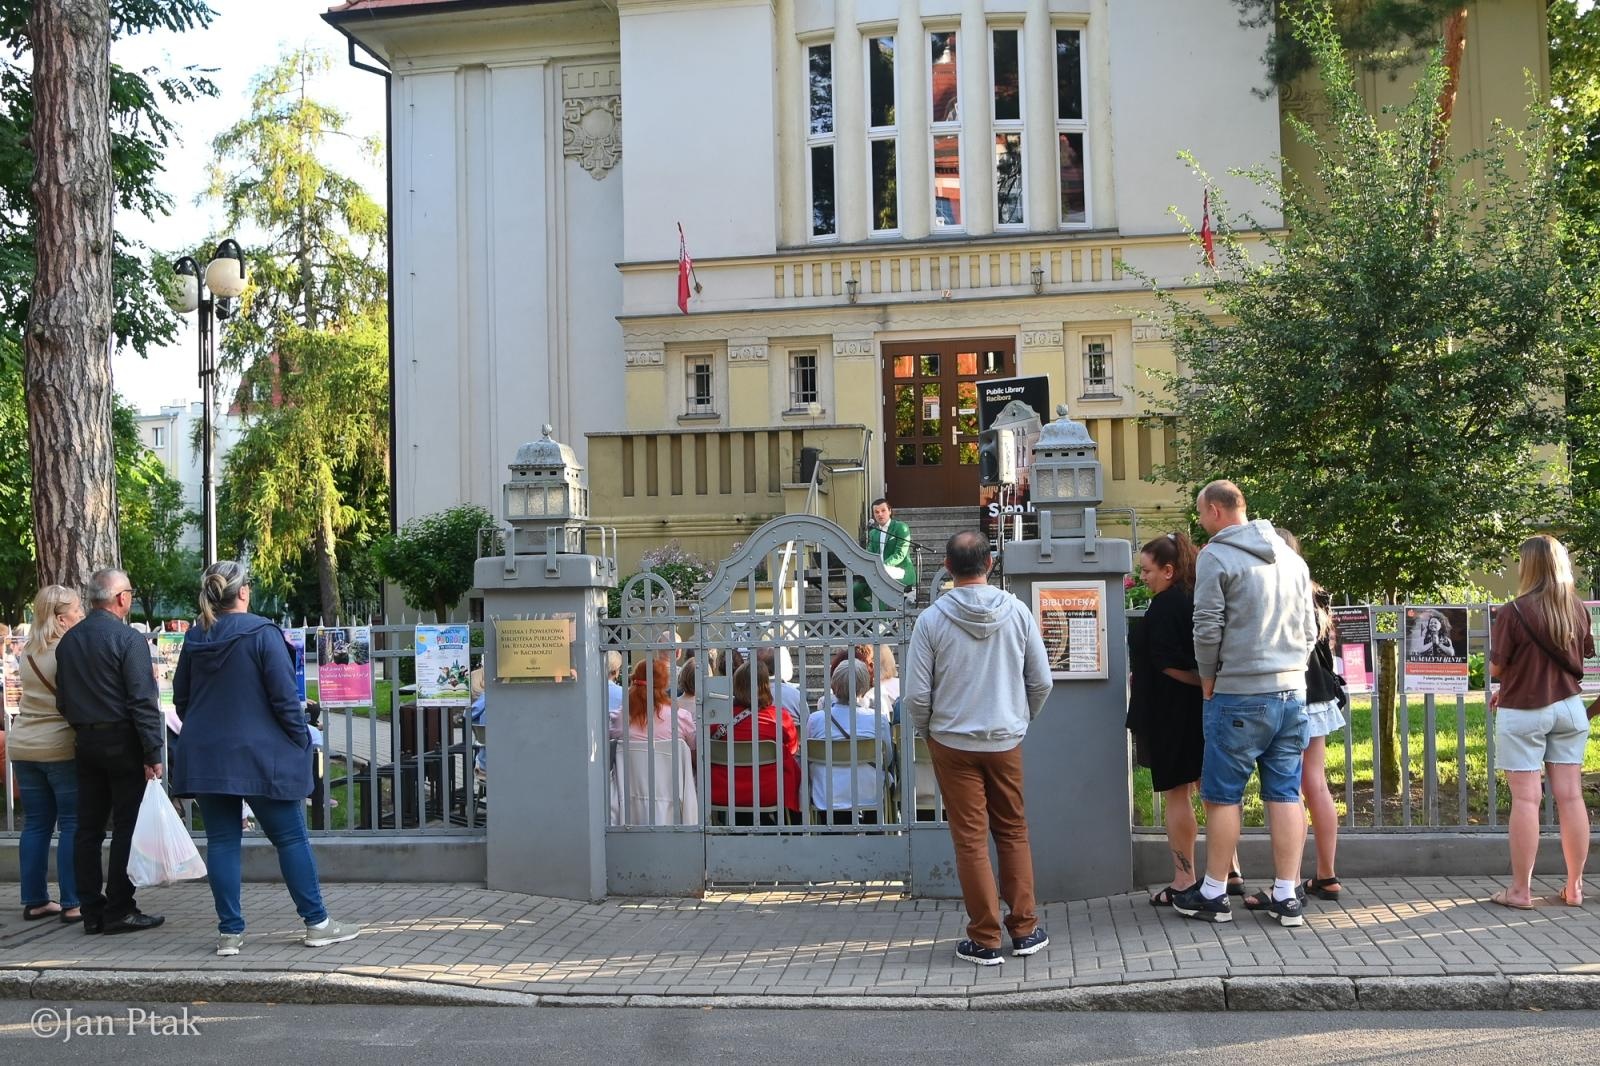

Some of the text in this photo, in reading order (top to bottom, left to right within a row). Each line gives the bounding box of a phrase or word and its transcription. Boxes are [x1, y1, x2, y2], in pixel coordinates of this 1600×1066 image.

[986, 386, 1025, 396] Public Library
[988, 502, 1024, 517] Sep
[1041, 598, 1096, 607] BIBLIOTEKA
